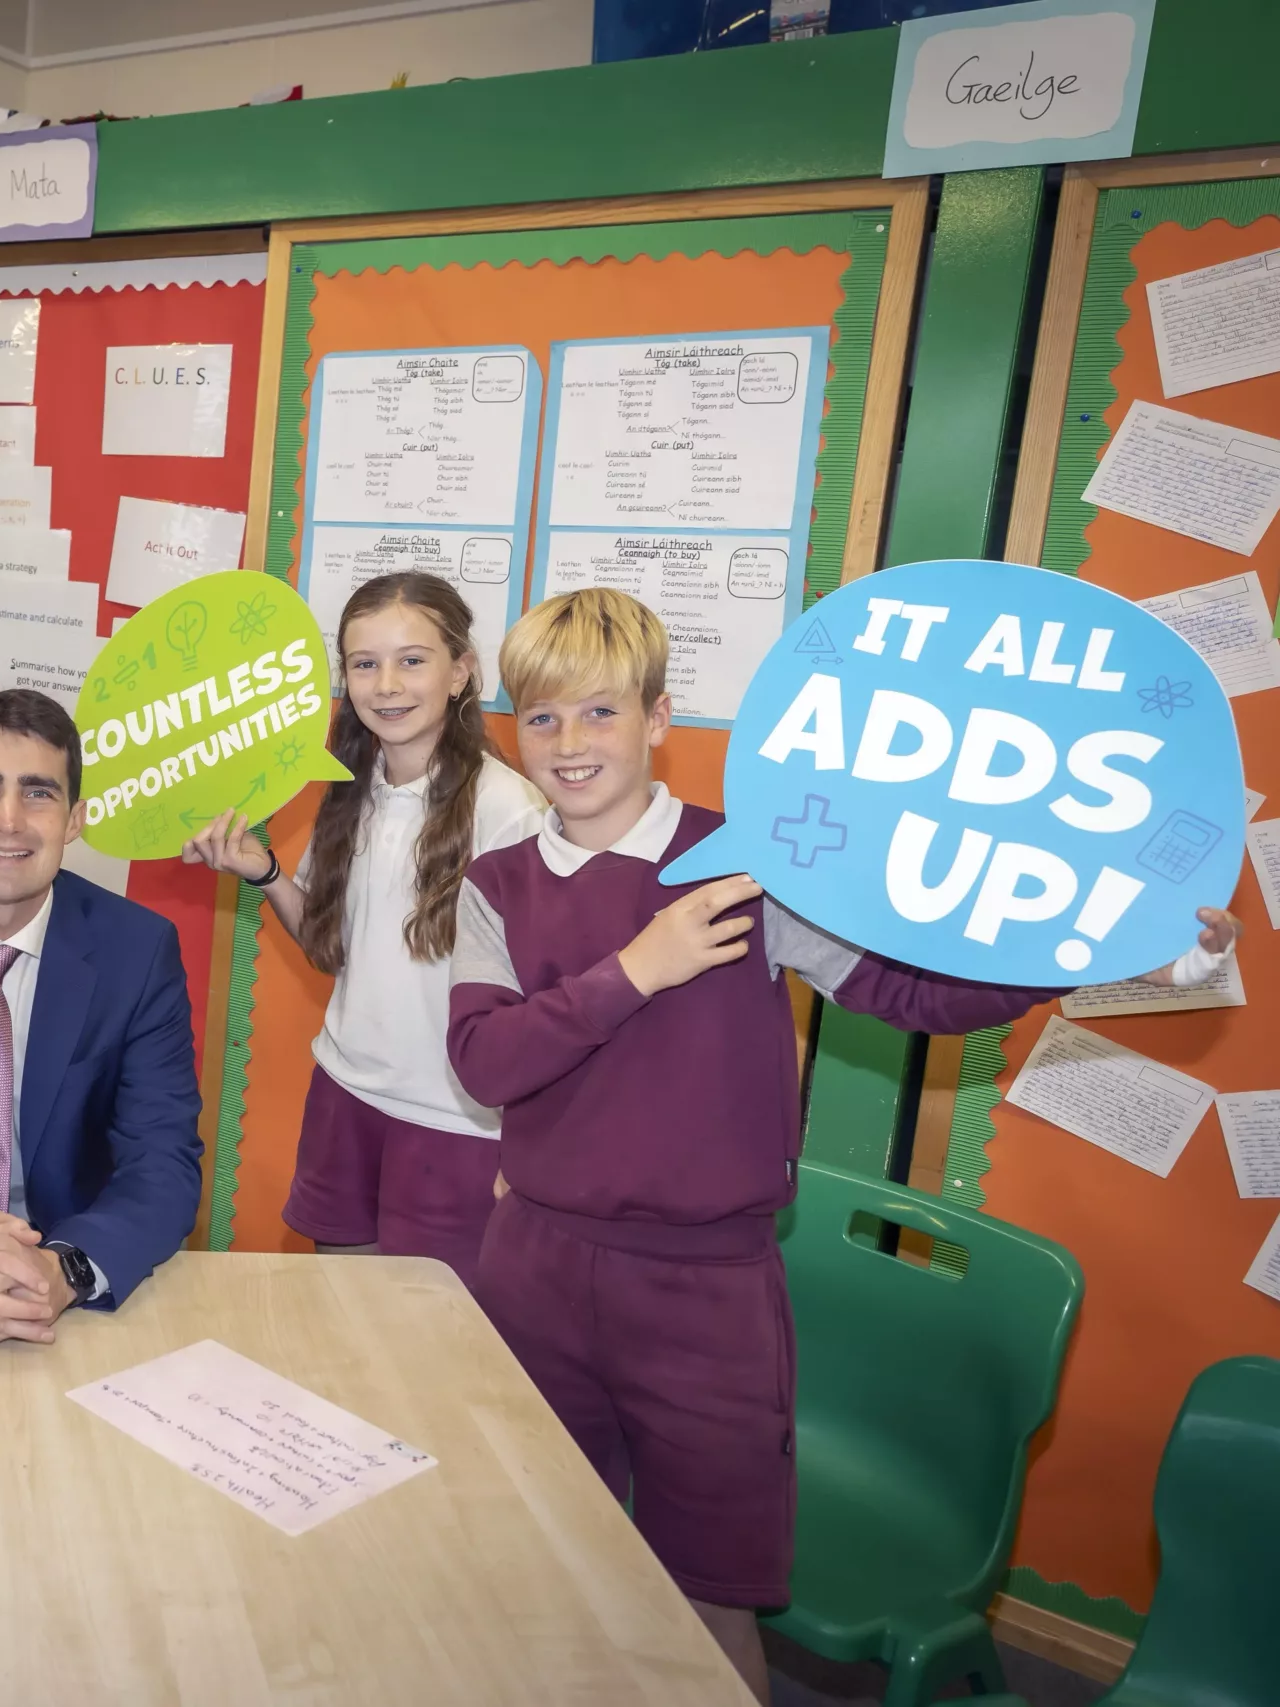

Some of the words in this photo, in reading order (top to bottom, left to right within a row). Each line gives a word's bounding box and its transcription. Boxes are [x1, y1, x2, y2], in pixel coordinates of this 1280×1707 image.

[945, 50, 1081, 120] Gaeilge
[11, 161, 60, 200] Mata
[645, 348, 681, 359] Aimsir
[683, 344, 744, 357] Láithreach
[397, 359, 426, 369] Aimsir
[429, 358, 458, 368] Chaite
[654, 359, 670, 369] Tóg
[674, 358, 701, 369] (take)
[421, 368, 444, 377] (take)
[402, 443, 418, 451] Cuir
[420, 443, 438, 452] (put)
[651, 441, 669, 449] Cuir
[672, 441, 694, 450] (put)
[380, 535, 409, 545] Aimsir
[411, 535, 440, 545] Chaite
[614, 537, 649, 548] Aimsir
[652, 538, 713, 551] Láithreach
[144, 540, 163, 554] Act
[166, 543, 173, 555] it
[177, 546, 198, 560] Out
[374, 544, 409, 553] Ceannaigh
[411, 545, 422, 553] (to
[424, 546, 441, 554] buy)
[618, 548, 660, 559] Ceannaigh
[664, 550, 677, 559] (to
[681, 550, 701, 560] buy)
[5, 562, 38, 575] strategy
[29, 613, 45, 623] and
[46, 615, 83, 627] calculate
[852, 597, 950, 663] IT
[963, 613, 1127, 693] ALL
[10, 658, 56, 674] Summarise
[58, 665, 76, 677] how
[77, 670, 88, 679] yo
[16, 676, 30, 686] got
[31, 678, 51, 688] your
[52, 682, 82, 693] answer
[80, 638, 314, 767] COUNTLESS
[84, 682, 322, 826] OPPORTUNITIES
[757, 672, 1166, 834] ADDS
[885, 810, 1147, 973] UP!
